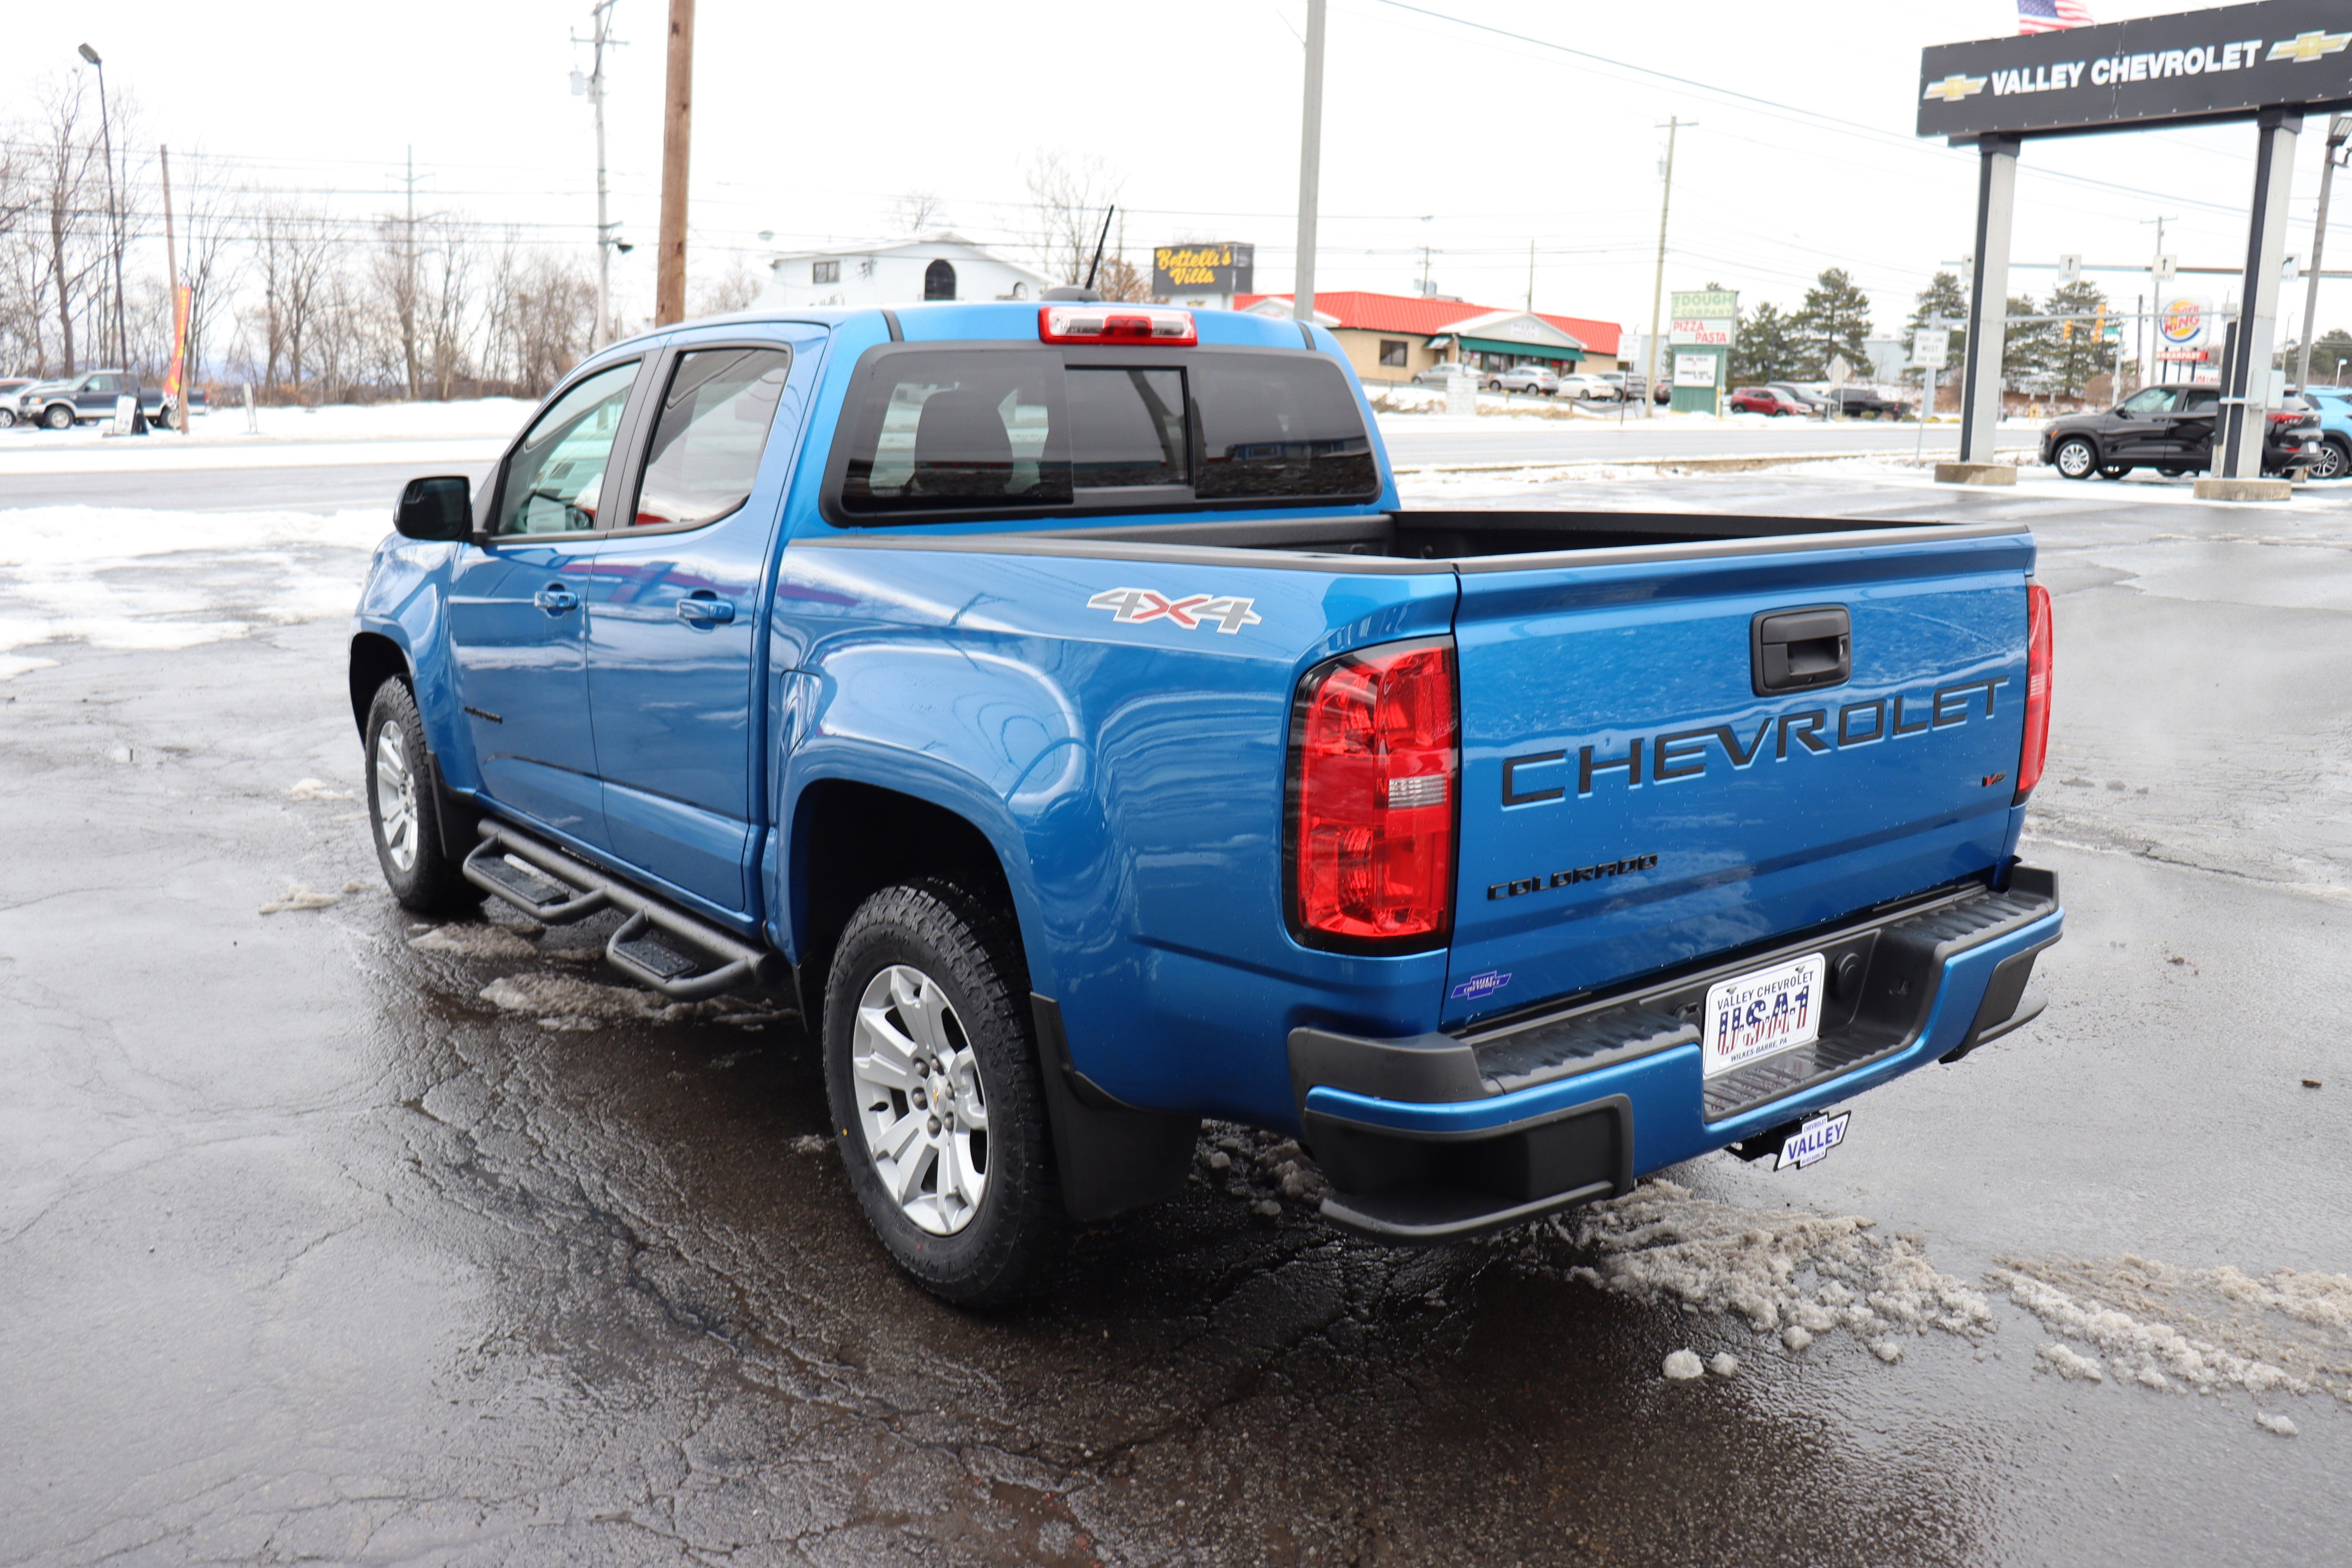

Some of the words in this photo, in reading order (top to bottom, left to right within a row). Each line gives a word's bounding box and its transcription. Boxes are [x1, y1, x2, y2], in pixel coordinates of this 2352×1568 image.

[1991, 61, 2085, 96] VALLEY
[2090, 39, 2263, 86] CHEVROLET
[1156, 244, 1232, 270] Bettelli's
[1169, 267, 1216, 285] Villa
[1682, 294, 1732, 306] DOUGH
[1682, 308, 1731, 316] COMPANY
[1673, 320, 1704, 332] PIZZA
[1695, 331, 1726, 343] PASTA
[1501, 676, 2009, 809] CHEVROLET
[1487, 853, 1658, 900] COLORADO
[1717, 989, 1754, 1010] VALLEY
[1757, 971, 1814, 997] CHEVROLET
[1780, 1037, 1787, 1045] PA
[1788, 1121, 1844, 1160] VALLEY
